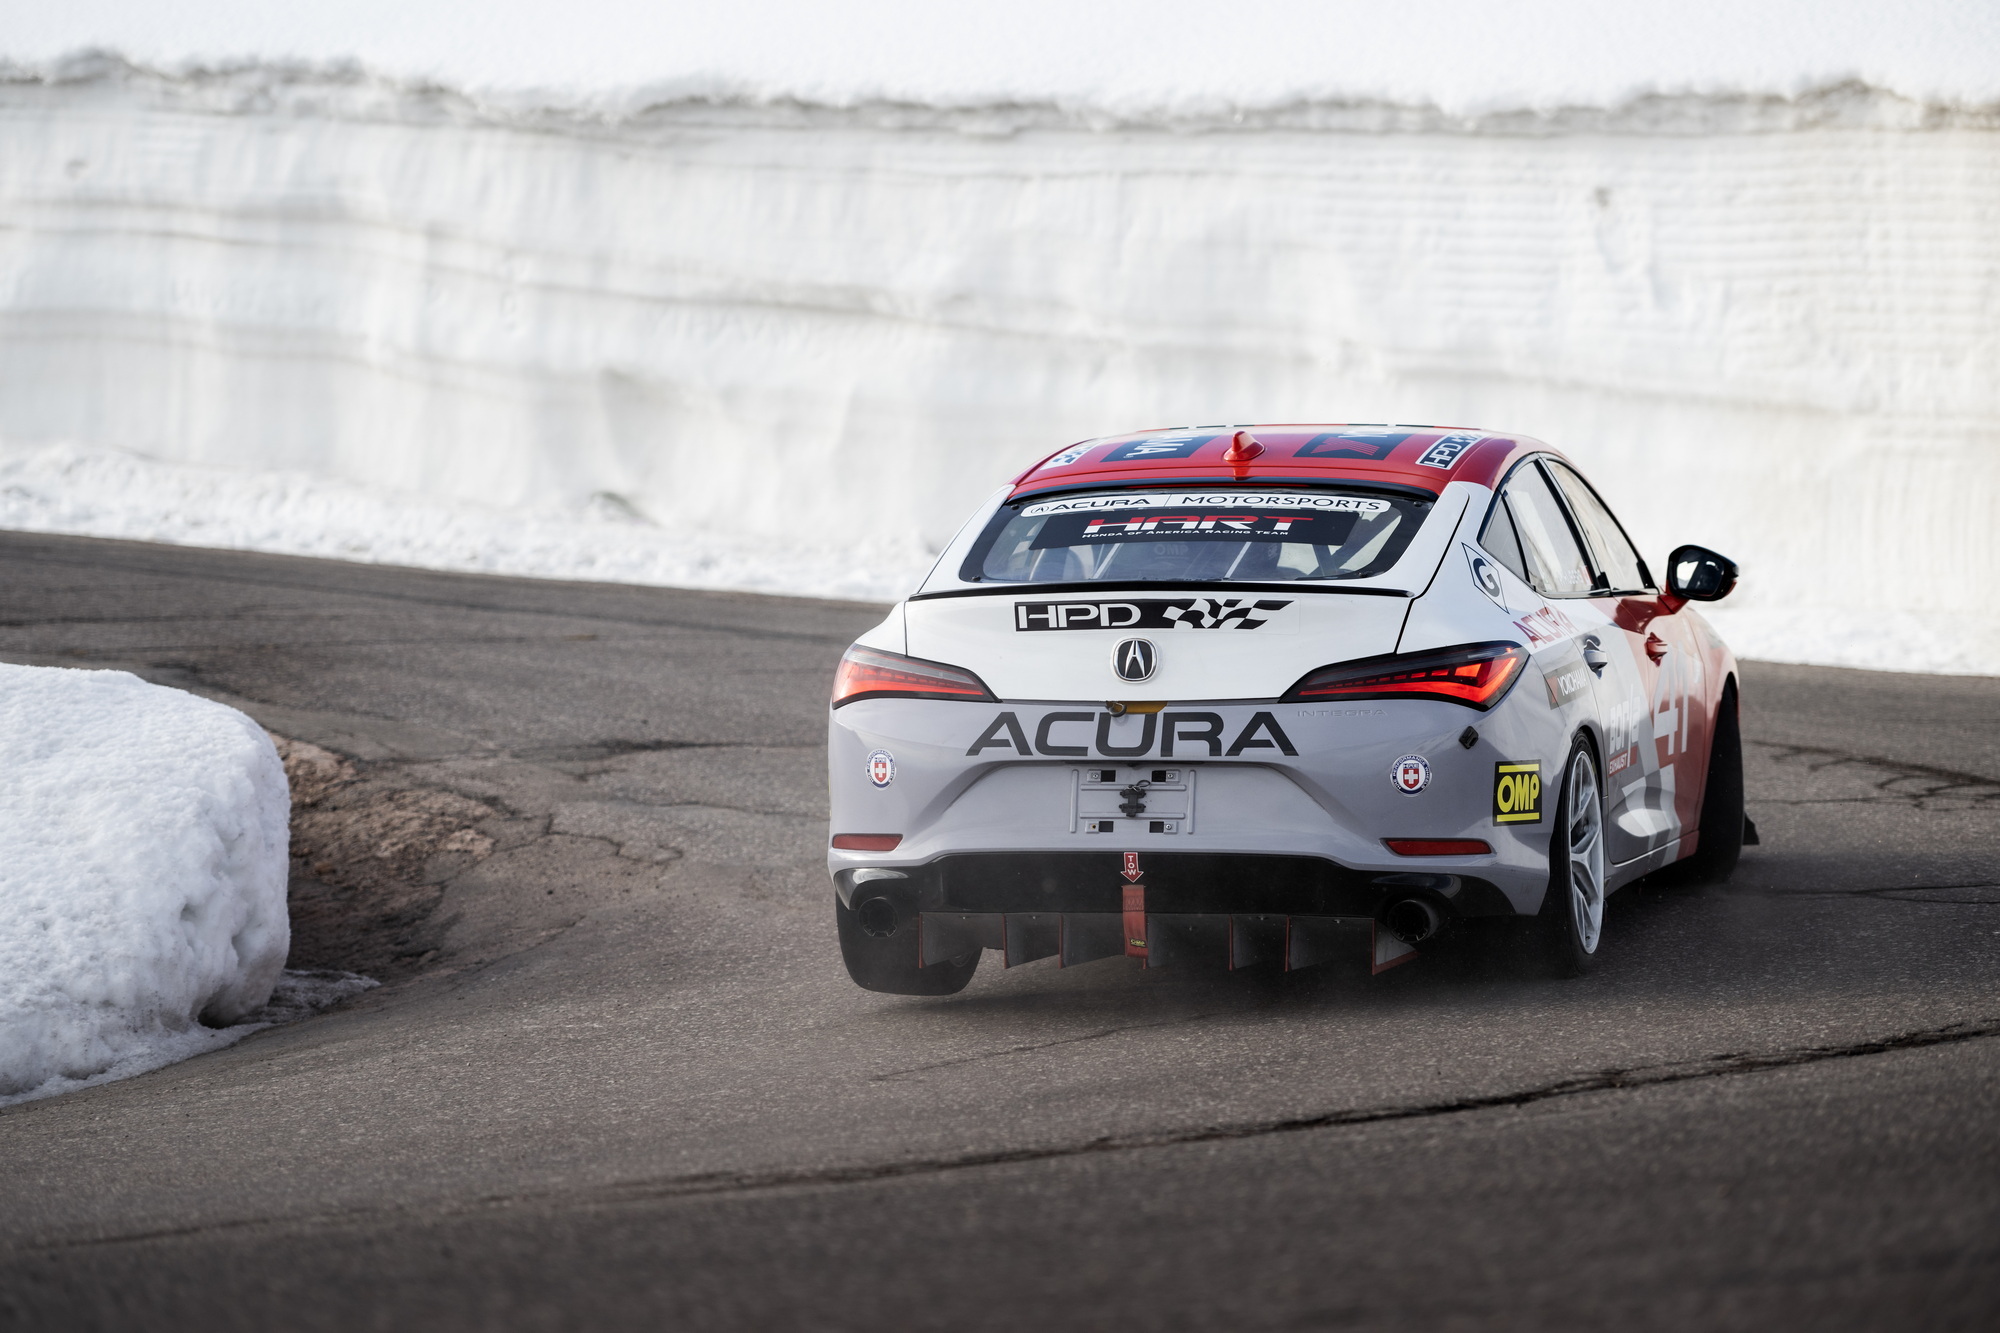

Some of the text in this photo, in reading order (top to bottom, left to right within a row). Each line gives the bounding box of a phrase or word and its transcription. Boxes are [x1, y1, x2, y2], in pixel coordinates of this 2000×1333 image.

[1424, 443, 1462, 467] HPD
[1050, 496, 1381, 512] ACURA MOTORSPORTS
[1084, 515, 1314, 534] HART
[1473, 558, 1500, 597] G
[1018, 603, 1141, 629] HPD
[1512, 604, 1579, 648] ACURA
[1298, 709, 1387, 717] INTEGRA
[965, 712, 1299, 757] ACURA
[1609, 752, 1627, 775] EXHAUST
[1497, 774, 1539, 813] OMP
[1128, 855, 1136, 875] TOW
